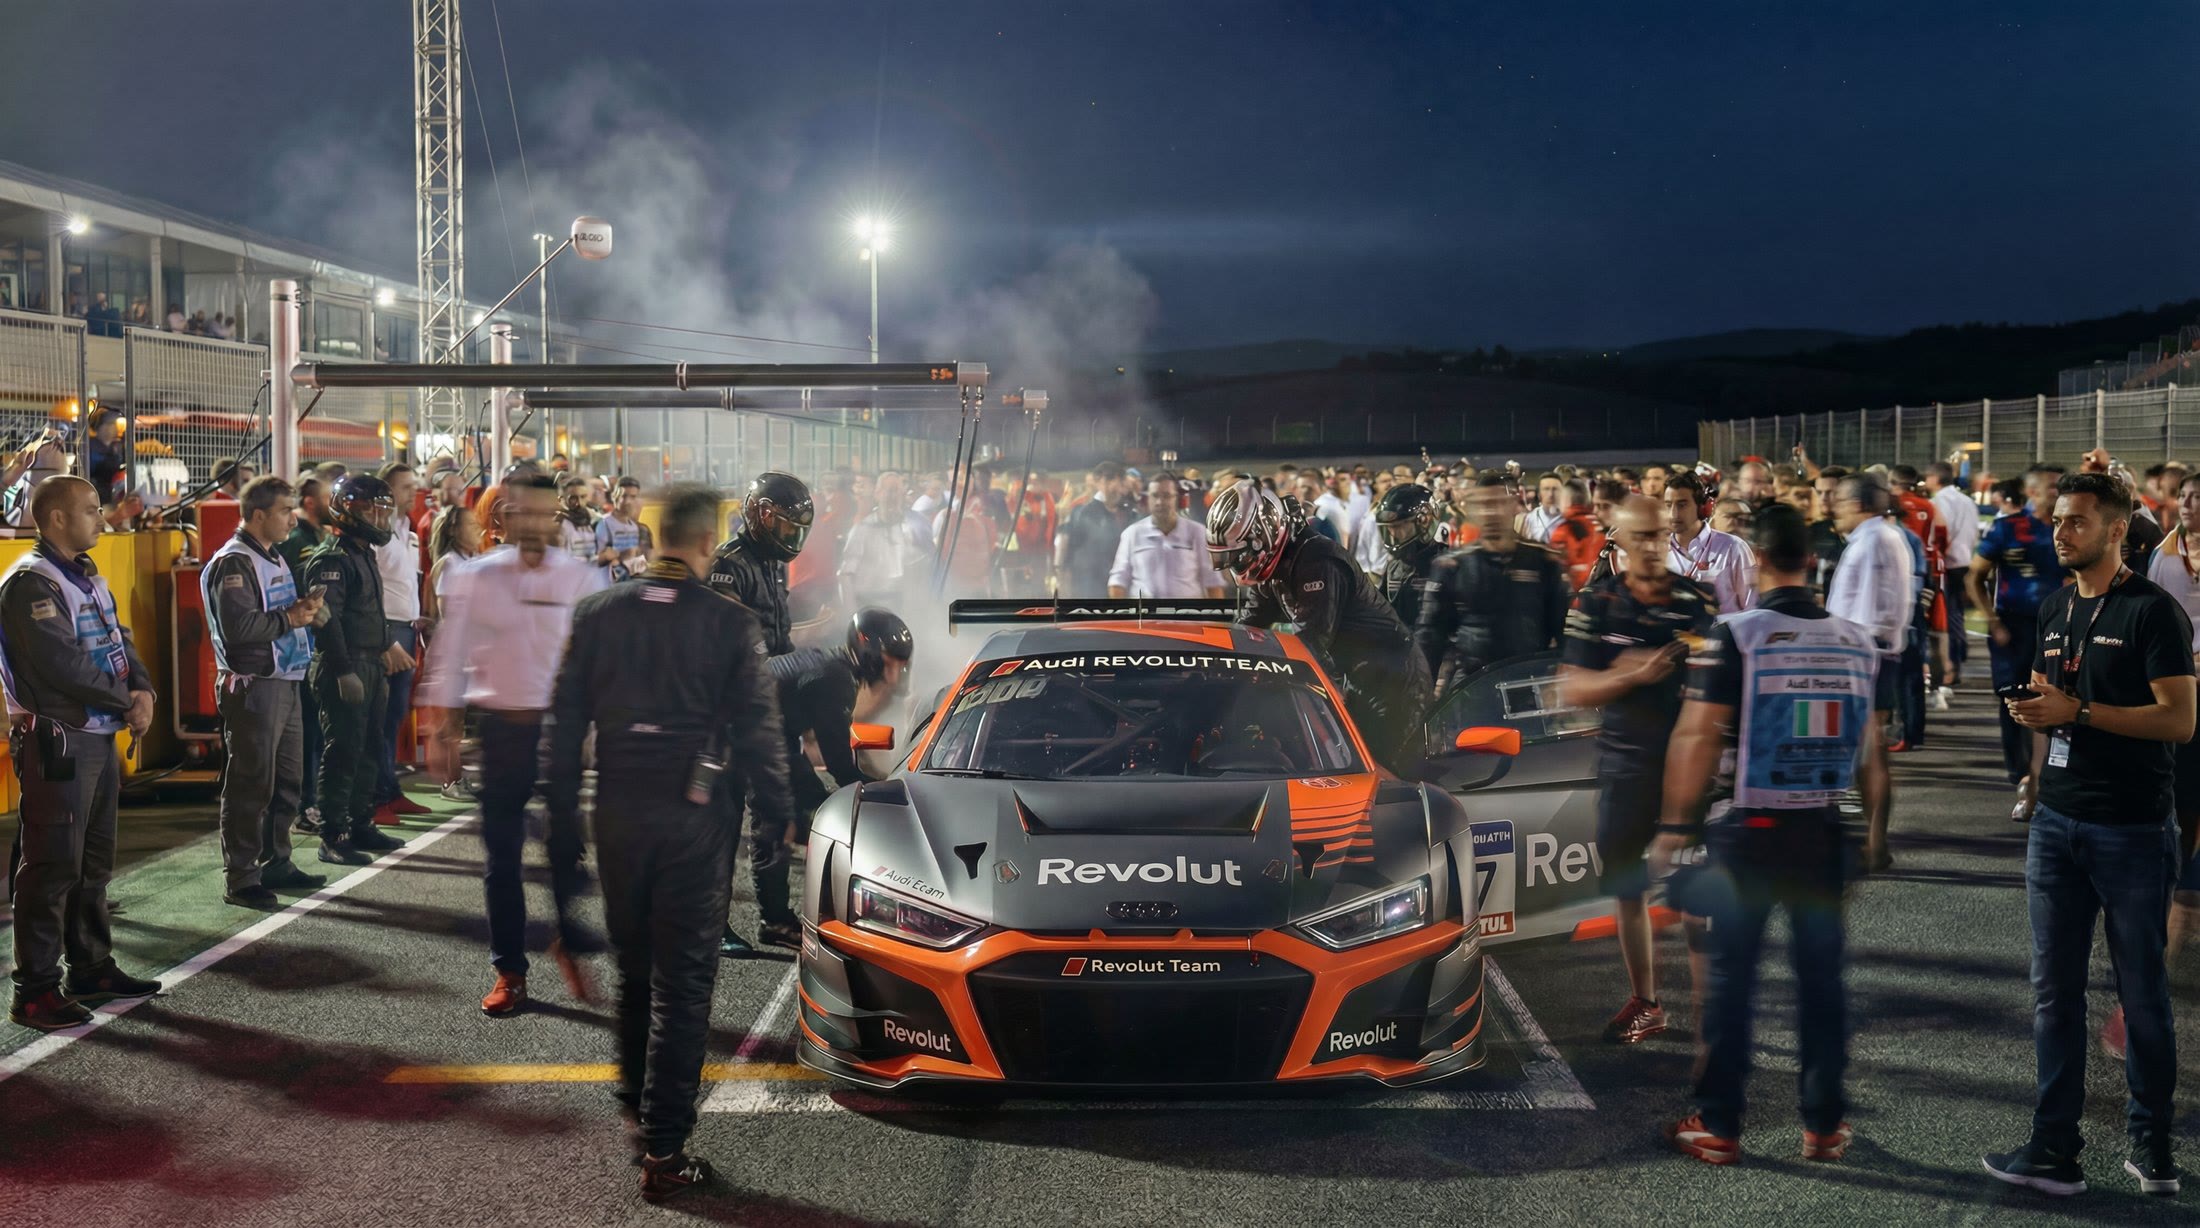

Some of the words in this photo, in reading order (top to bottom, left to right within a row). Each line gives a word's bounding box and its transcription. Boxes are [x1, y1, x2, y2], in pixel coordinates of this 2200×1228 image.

[1023, 656, 1085, 671] Audi
[1093, 655, 1214, 669] REVOLUT
[1219, 658, 1294, 675] TEAM
[885, 870, 914, 886] Audi
[912, 879, 945, 899] Ecam
[1037, 855, 1243, 886] Revolut
[1091, 959, 1165, 973] Revolut
[1169, 959, 1221, 973] Team
[883, 1019, 952, 1053] Revolut
[1330, 1021, 1397, 1052] Revolut
